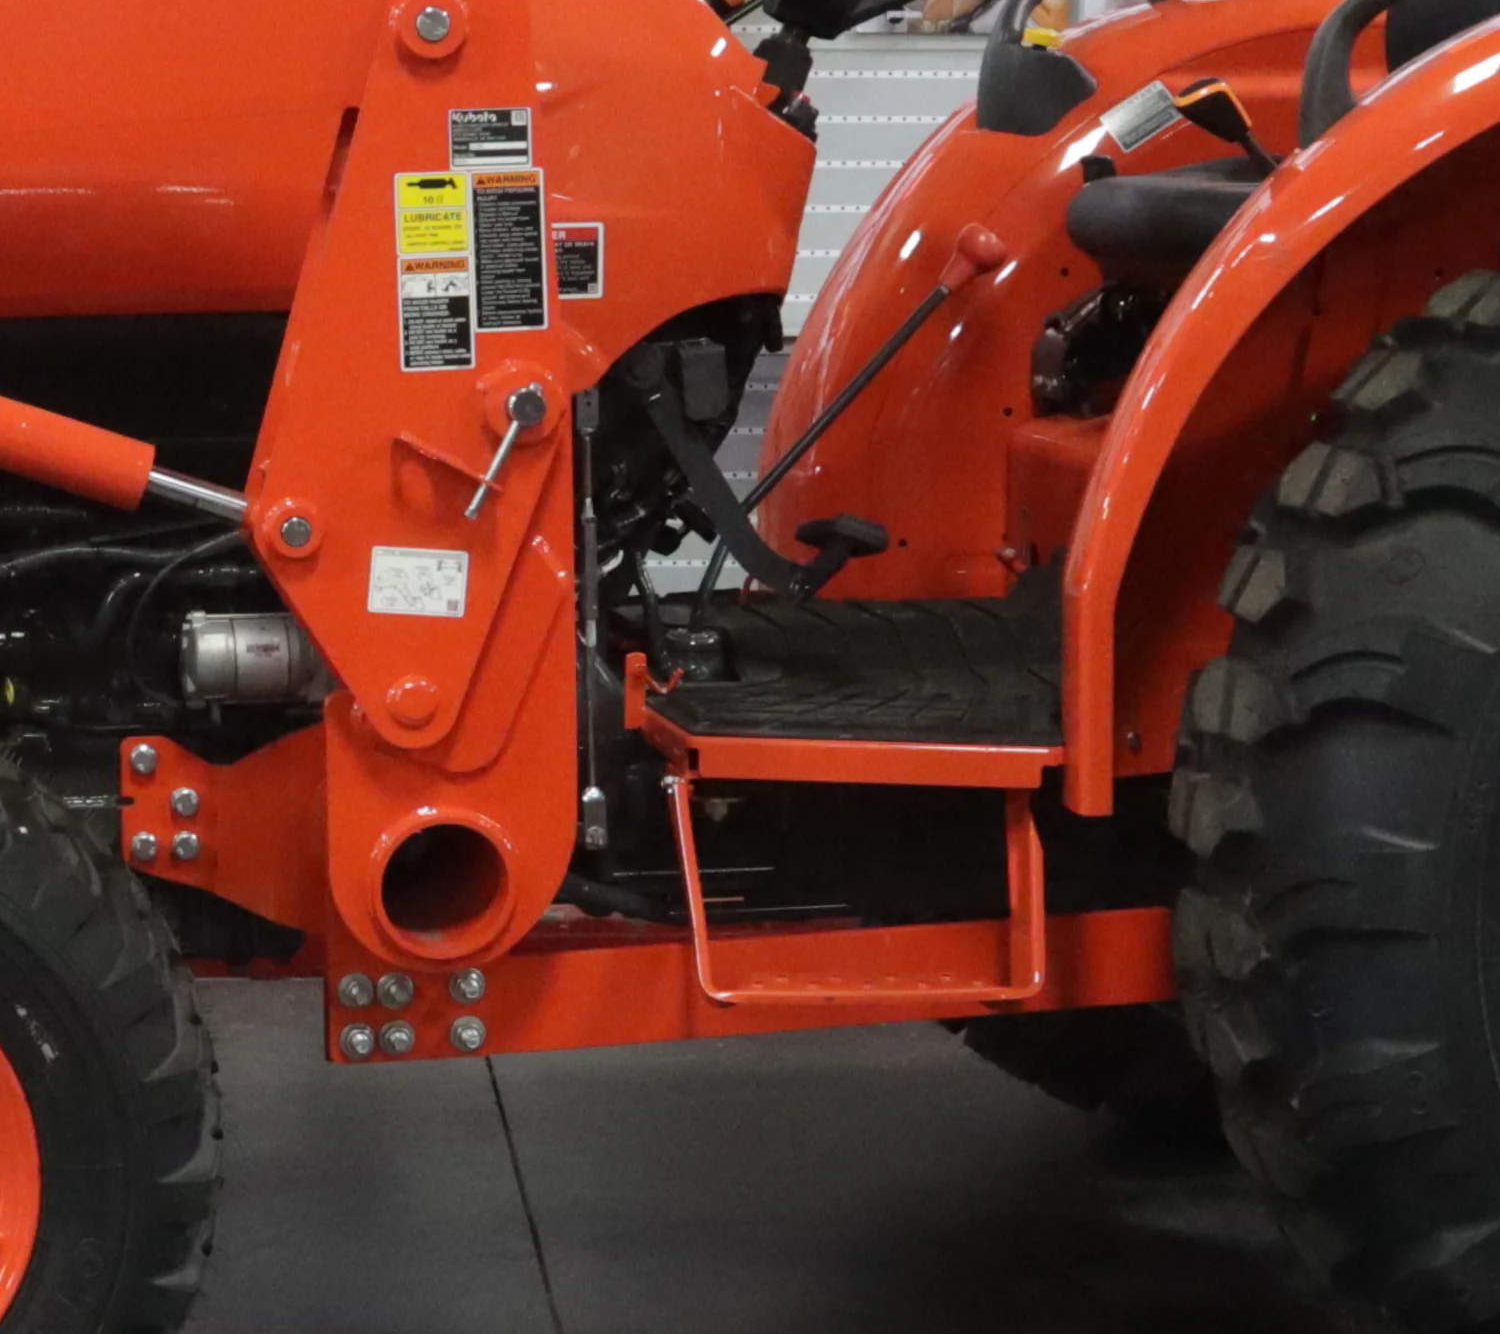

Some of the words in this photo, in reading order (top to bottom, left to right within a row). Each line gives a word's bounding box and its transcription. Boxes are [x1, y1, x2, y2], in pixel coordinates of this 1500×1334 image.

[452, 111, 498, 123] Kubota
[486, 175, 536, 185] WARNING
[423, 196, 434, 204] 10
[404, 212, 461, 223] LUBRICATE
[415, 260, 465, 270] WARNING
